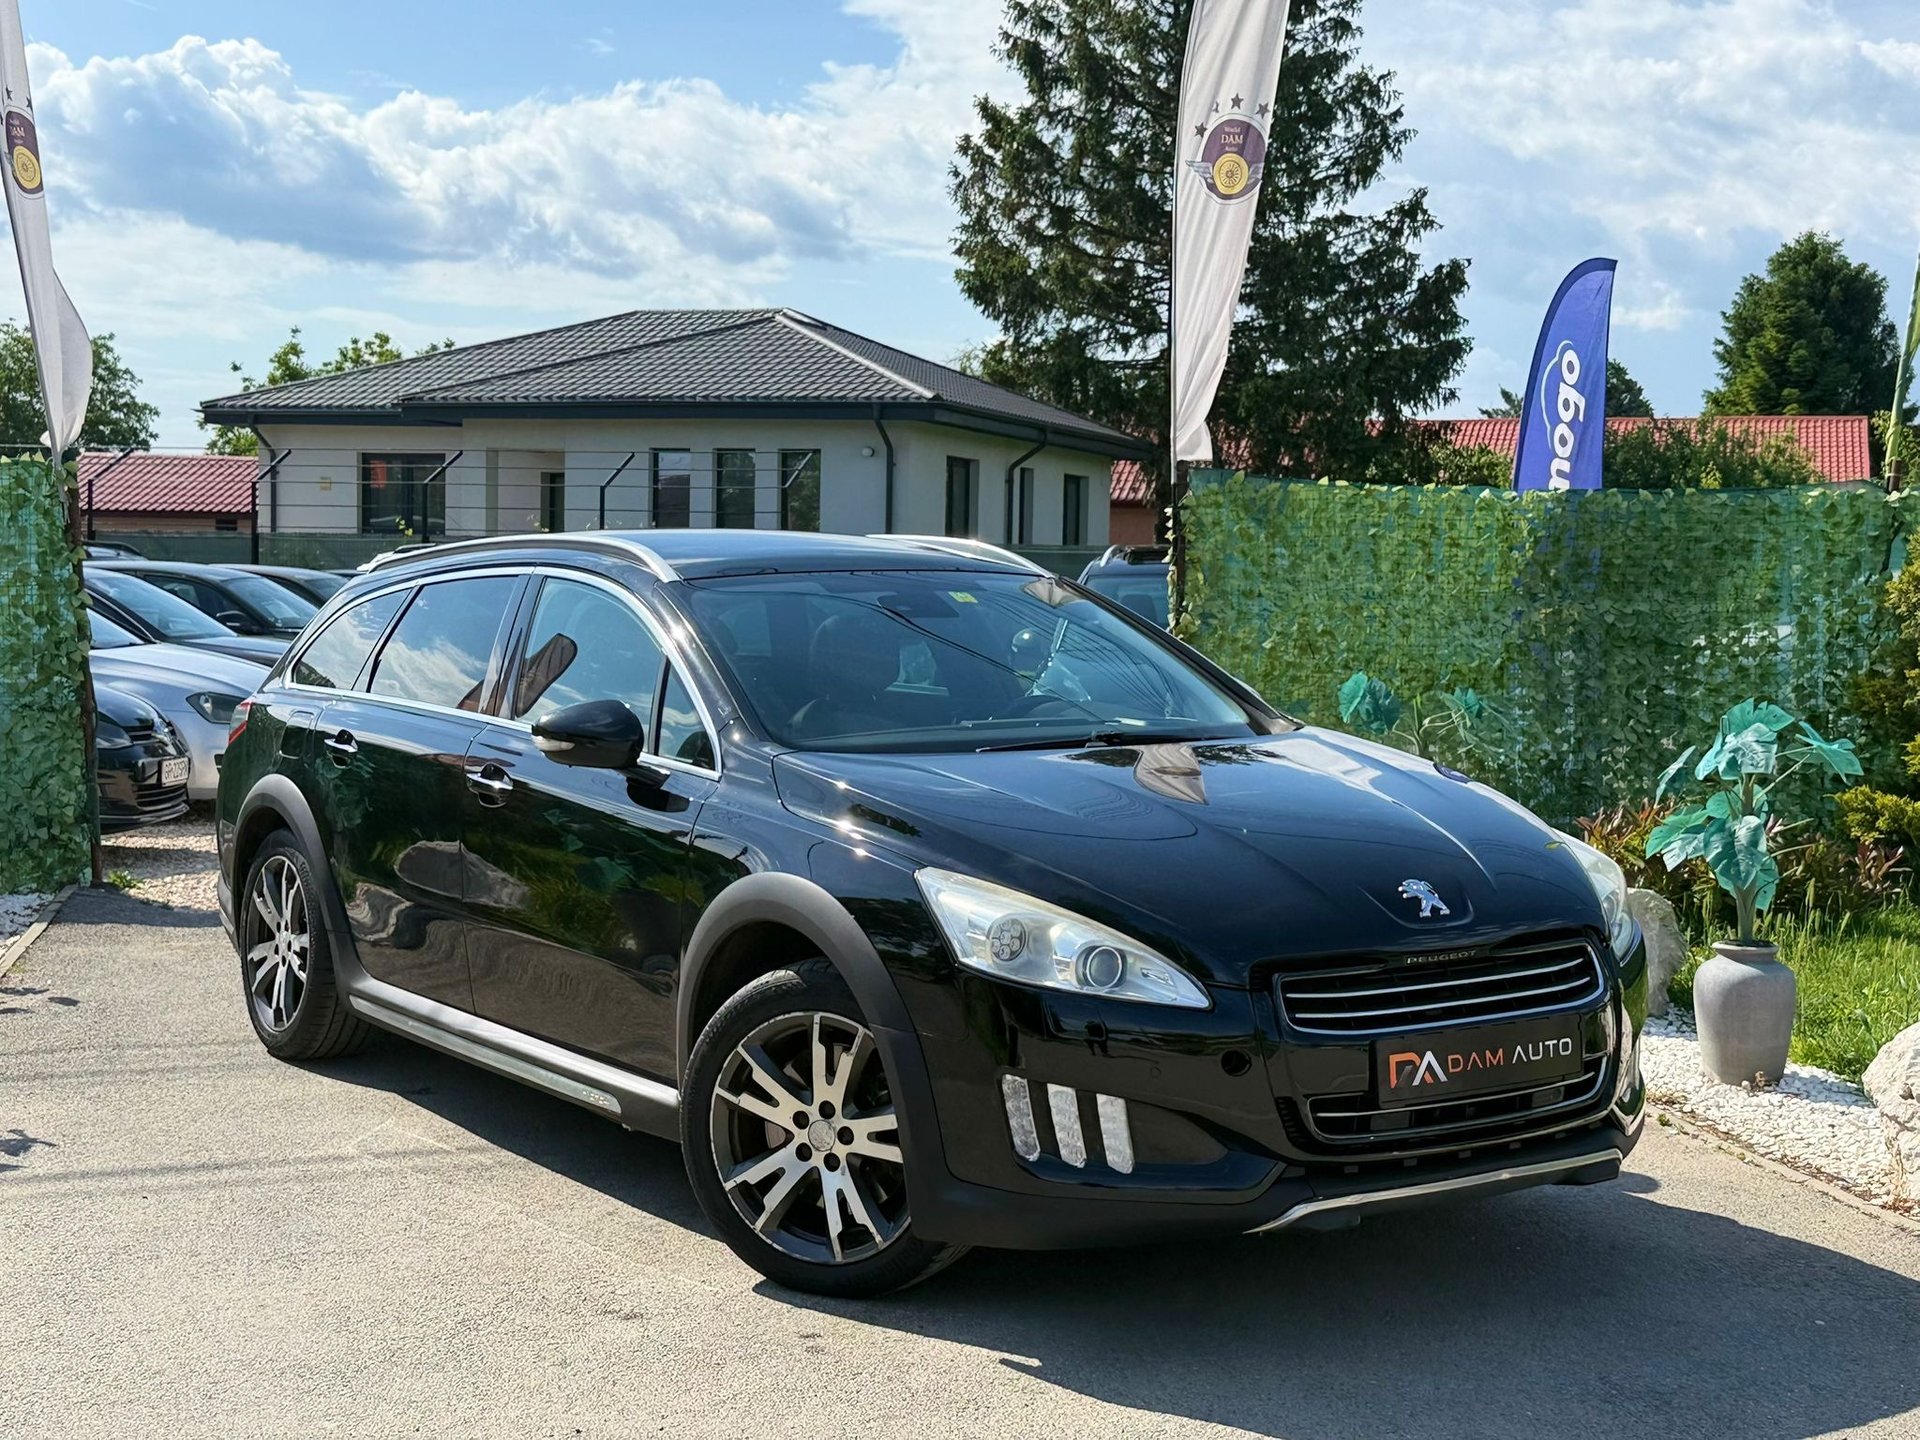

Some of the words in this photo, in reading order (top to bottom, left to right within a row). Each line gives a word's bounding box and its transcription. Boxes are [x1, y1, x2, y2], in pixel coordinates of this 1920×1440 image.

[1221, 134, 1244, 144] DAM
[1407, 950, 1477, 964] PEUGEOT
[1447, 1048, 1504, 1073] DAM
[1512, 1037, 1572, 1064] AUTO
